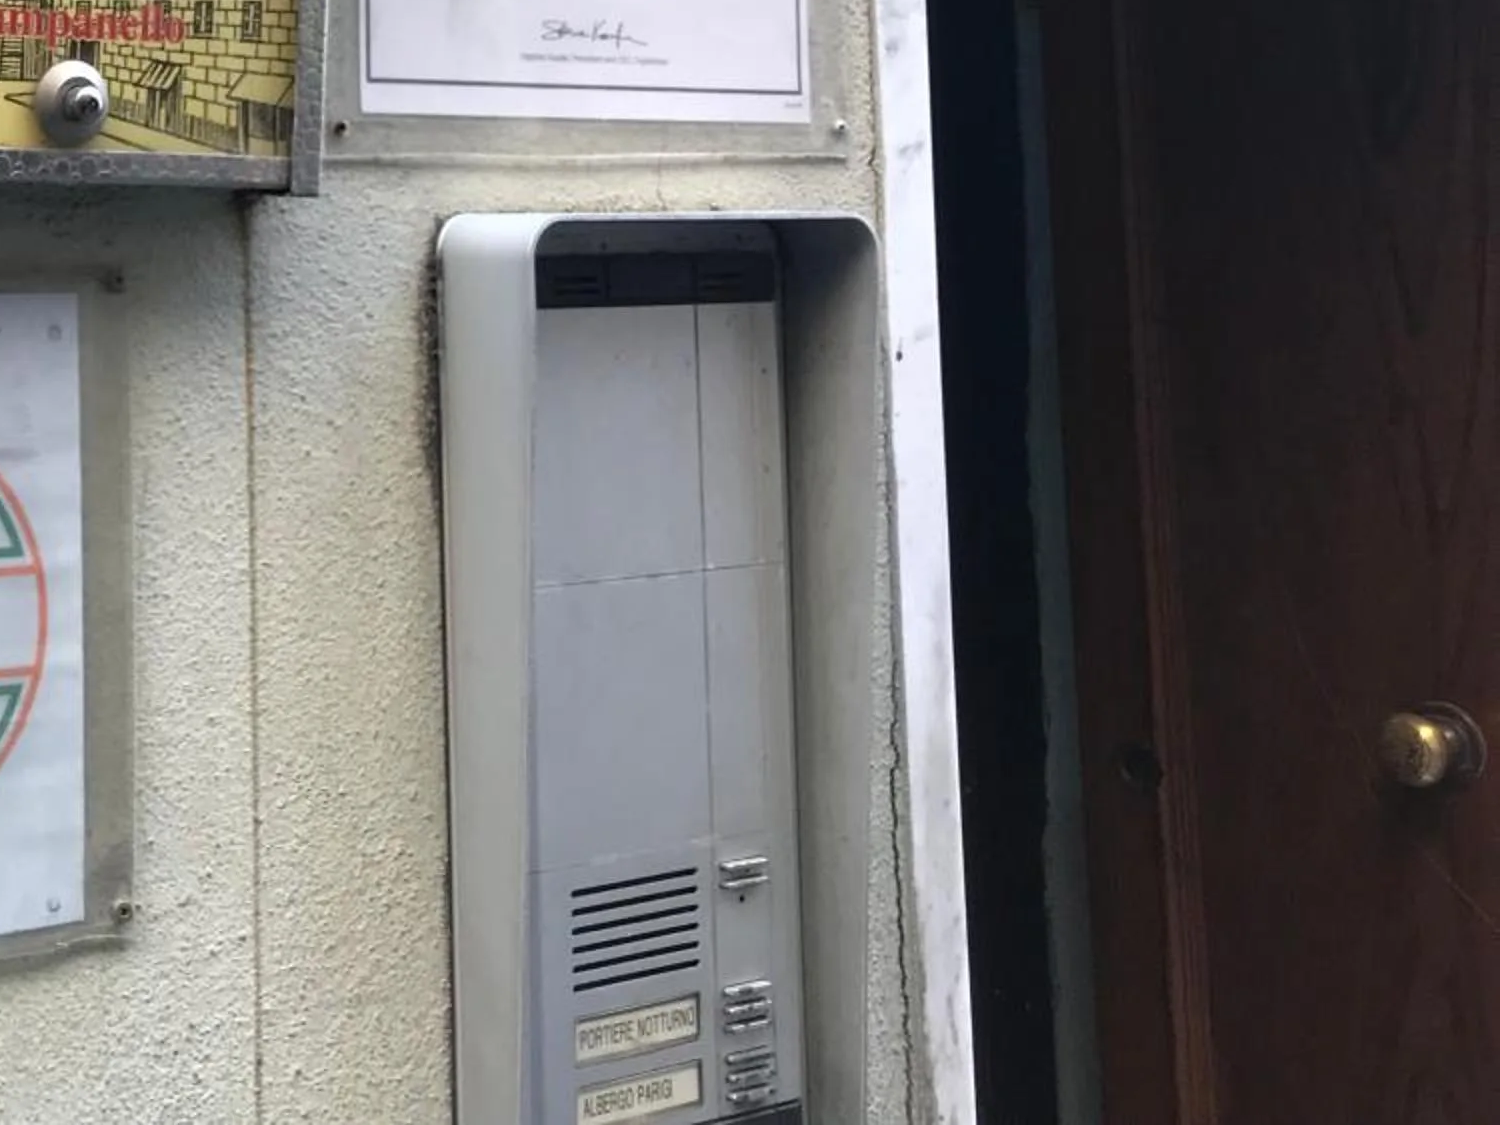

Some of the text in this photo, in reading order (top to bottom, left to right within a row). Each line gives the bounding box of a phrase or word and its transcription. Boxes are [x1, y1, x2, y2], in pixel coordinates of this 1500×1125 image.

[579, 1006, 695, 1052] PORTIERE NOTTURNO
[583, 1078, 673, 1118] ALBERGO PARIGI
